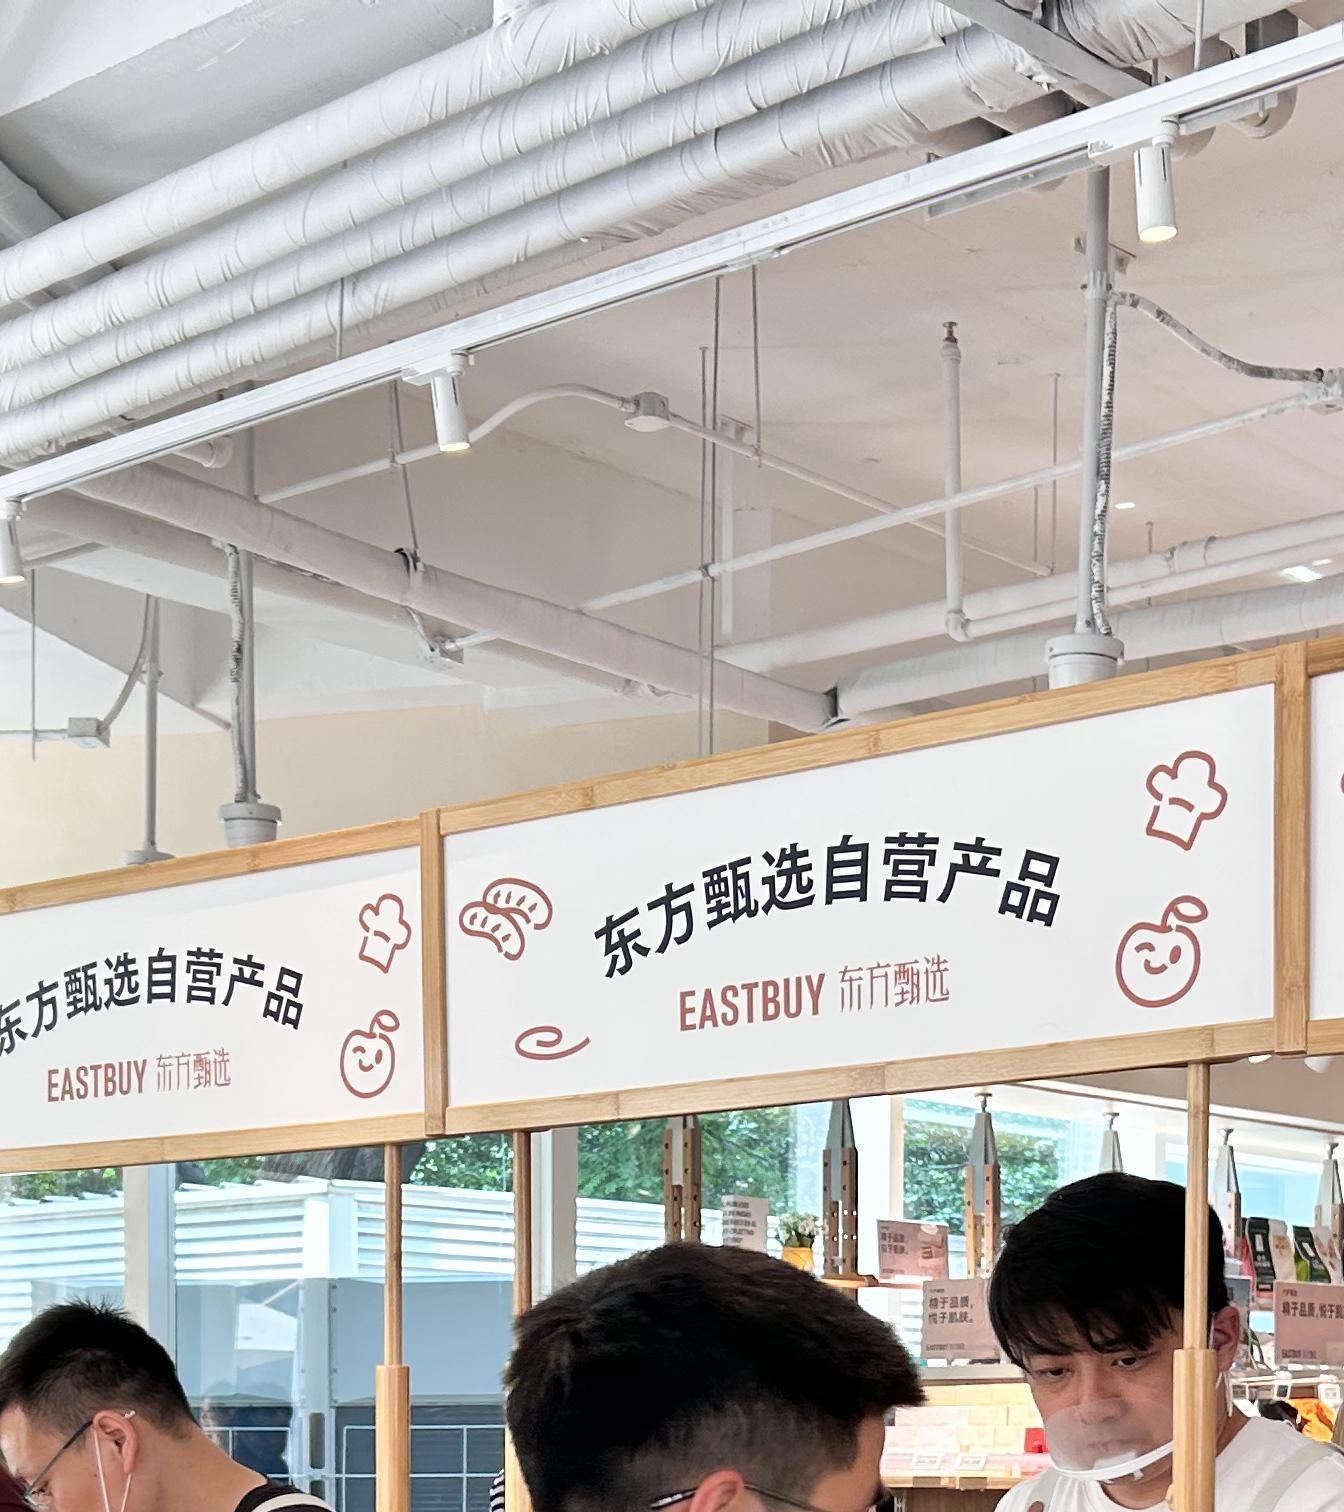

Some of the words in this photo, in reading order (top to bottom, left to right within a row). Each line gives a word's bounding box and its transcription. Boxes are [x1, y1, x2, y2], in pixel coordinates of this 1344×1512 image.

[594, 831, 1062, 980] 东方甄选自营产品
[679, 973, 825, 1032] EASTBUY
[839, 953, 949, 1013] 东方甄选
[46, 1059, 147, 1102] EASTBUY
[155, 1049, 231, 1091] 东方甄选
